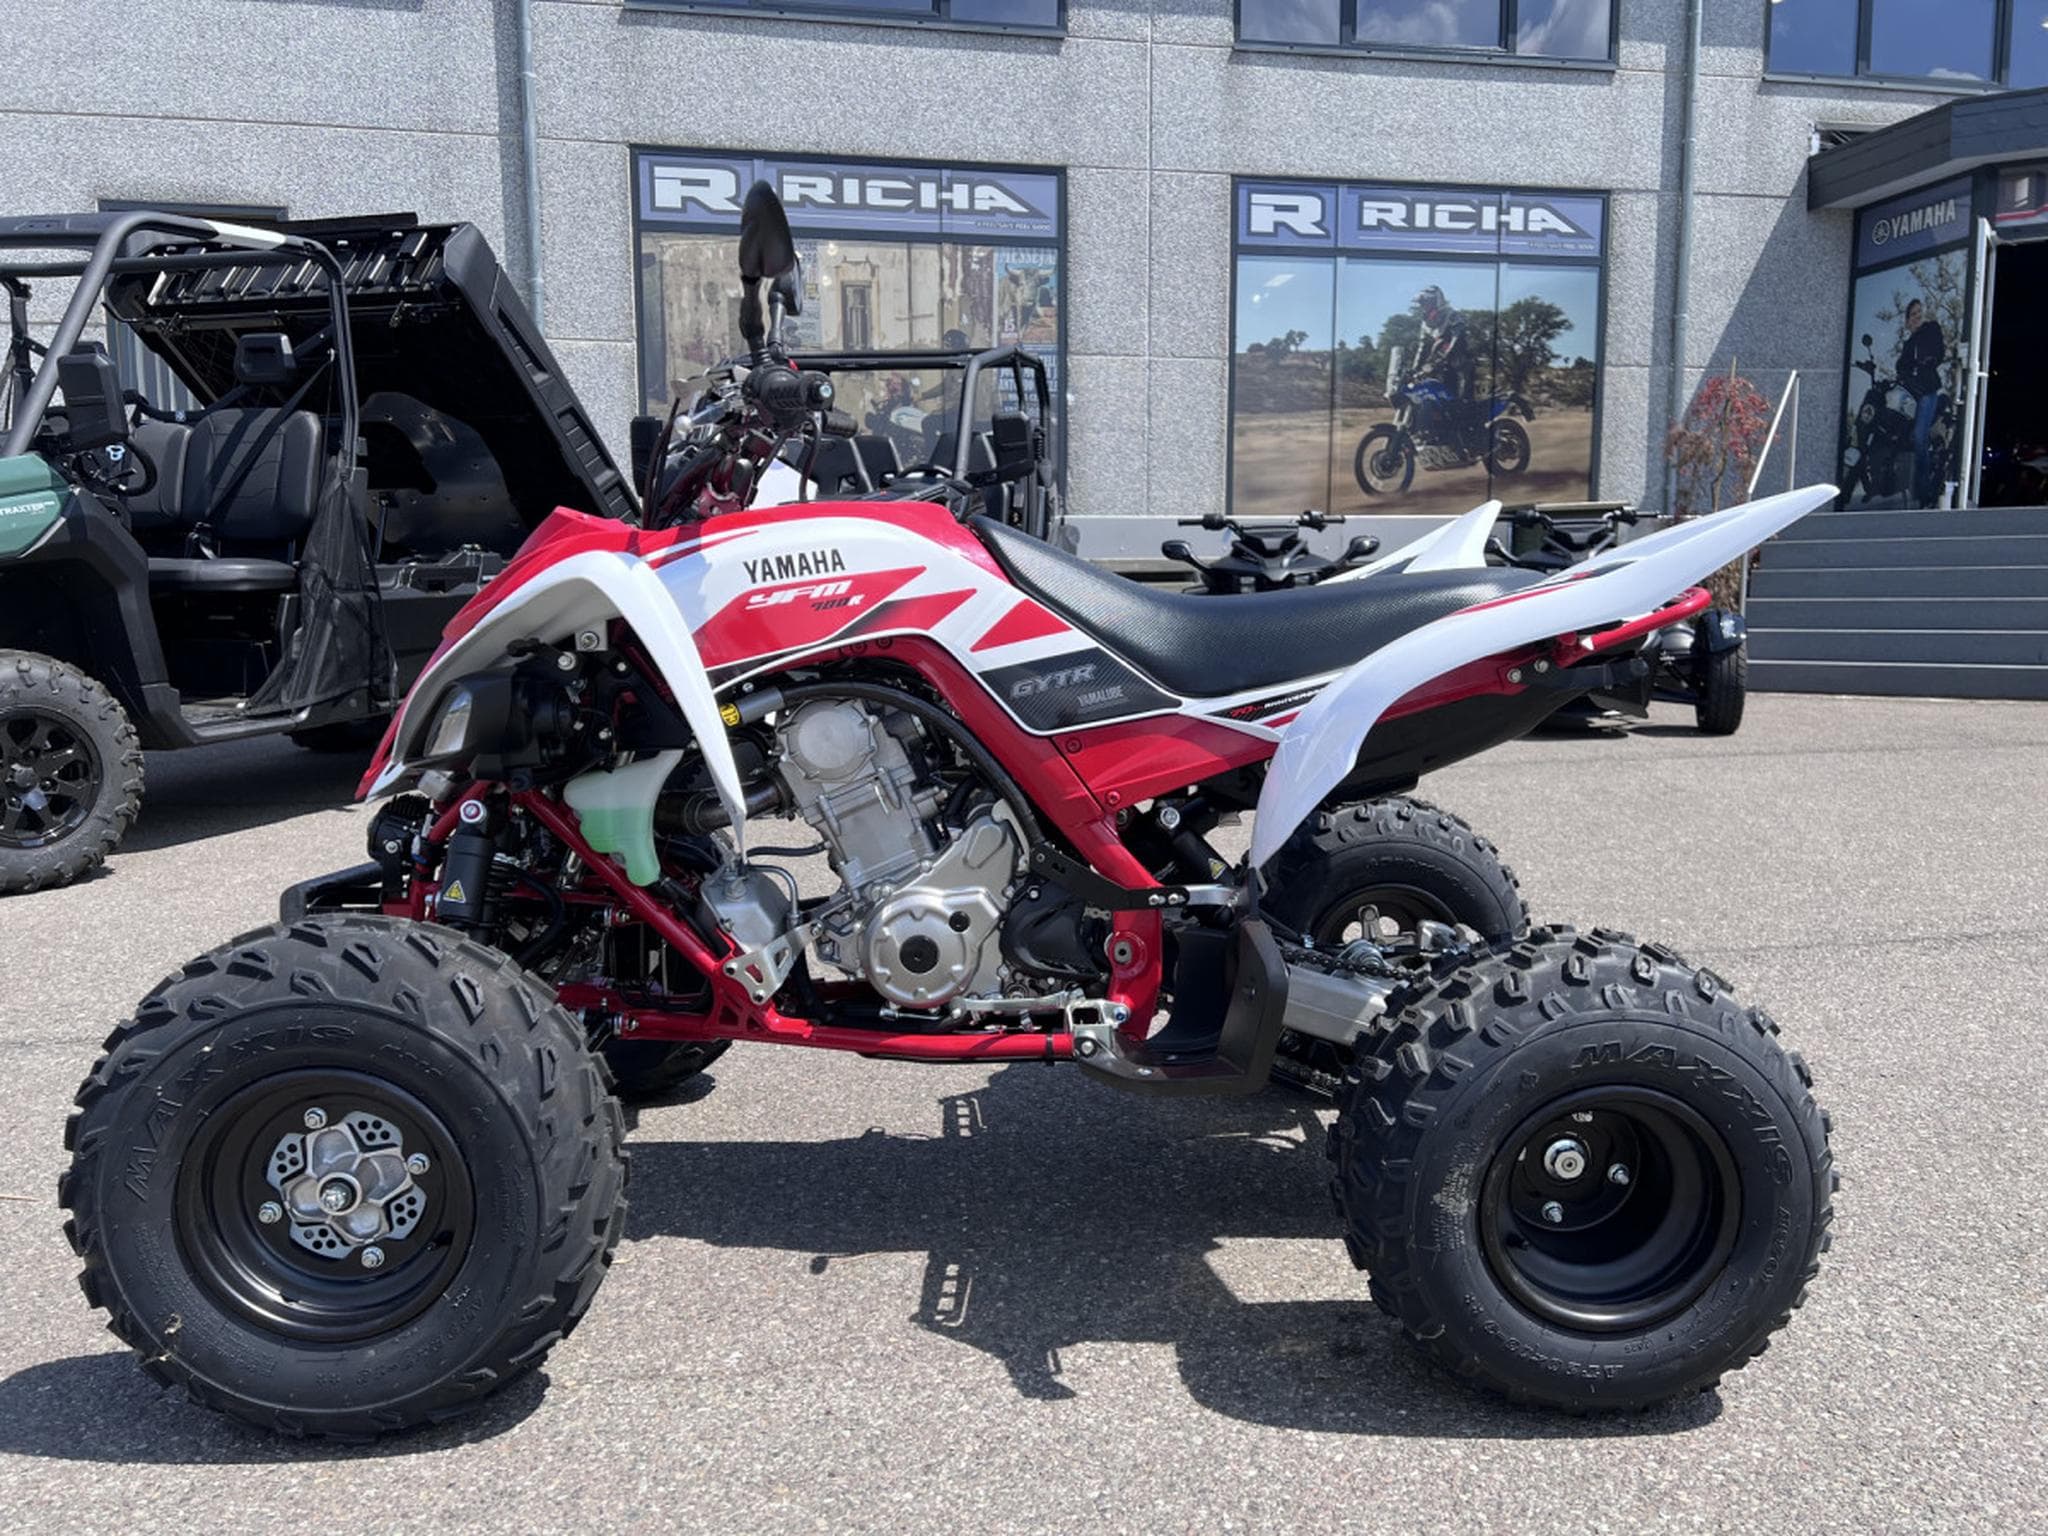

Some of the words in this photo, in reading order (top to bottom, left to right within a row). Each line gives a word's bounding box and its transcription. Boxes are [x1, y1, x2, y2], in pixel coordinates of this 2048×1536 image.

[783, 174, 1031, 213] RICHA
[1249, 192, 1327, 236] R
[1362, 199, 1577, 234] RICHA
[1891, 199, 1957, 239] YAMAHA
[743, 549, 846, 584] YAMAHA
[1010, 663, 1097, 700] GYTR
[124, 1024, 356, 1202] MAXXIS
[1570, 1040, 1794, 1185] MAXXIS
